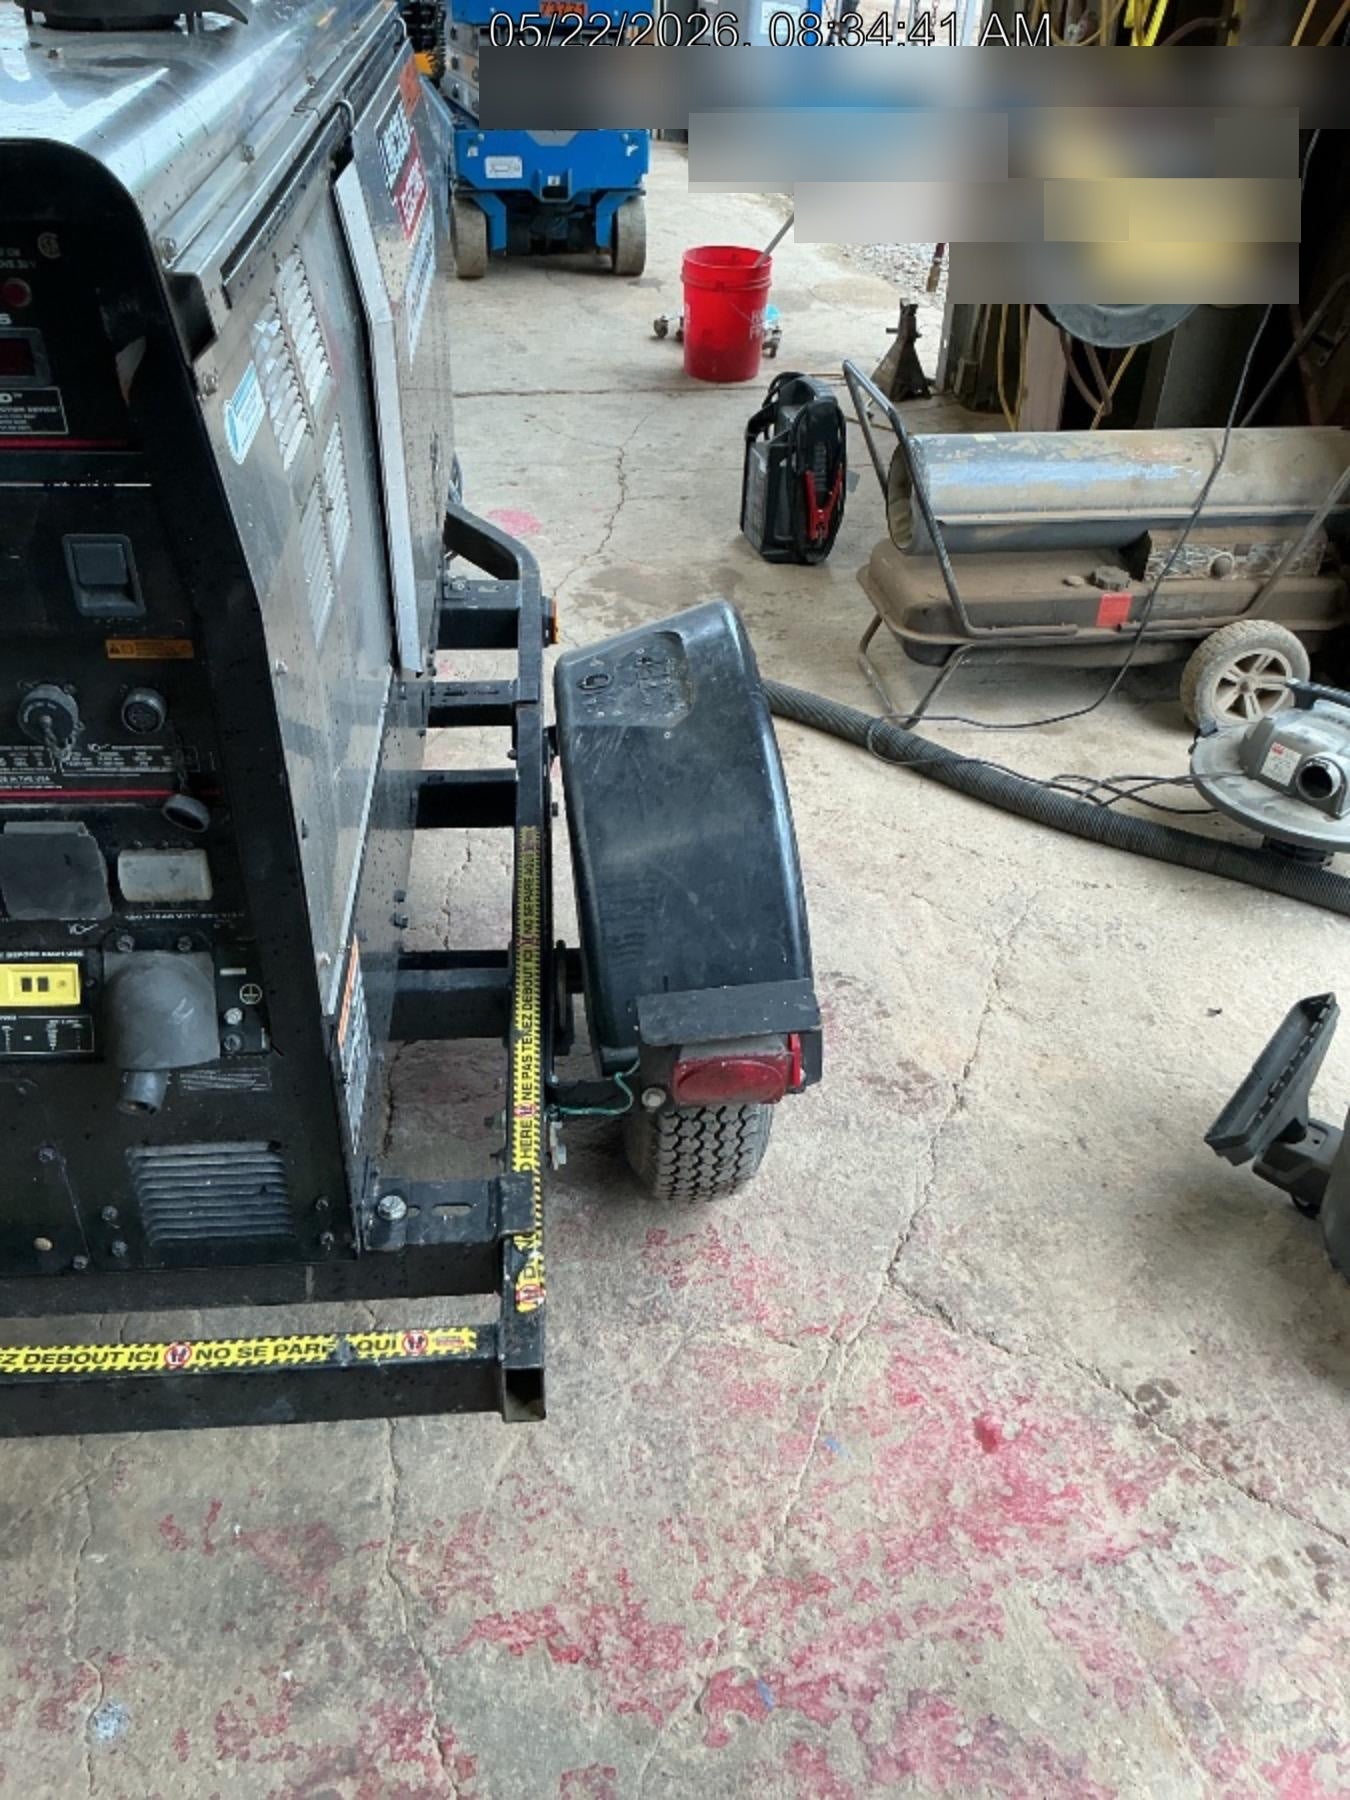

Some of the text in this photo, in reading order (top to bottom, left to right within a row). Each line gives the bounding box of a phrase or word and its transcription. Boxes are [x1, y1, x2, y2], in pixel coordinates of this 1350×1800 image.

[521, 1056, 533, 1082] PAS
[521, 1085, 533, 1102] NE
[520, 1117, 533, 1159] HERE
[23, 1351, 124, 1365] DEBOUT
[128, 1351, 159, 1362] ICI
[195, 1348, 231, 1360] NO
[237, 1345, 269, 1359] SE
[351, 1339, 397, 1352] QUI
